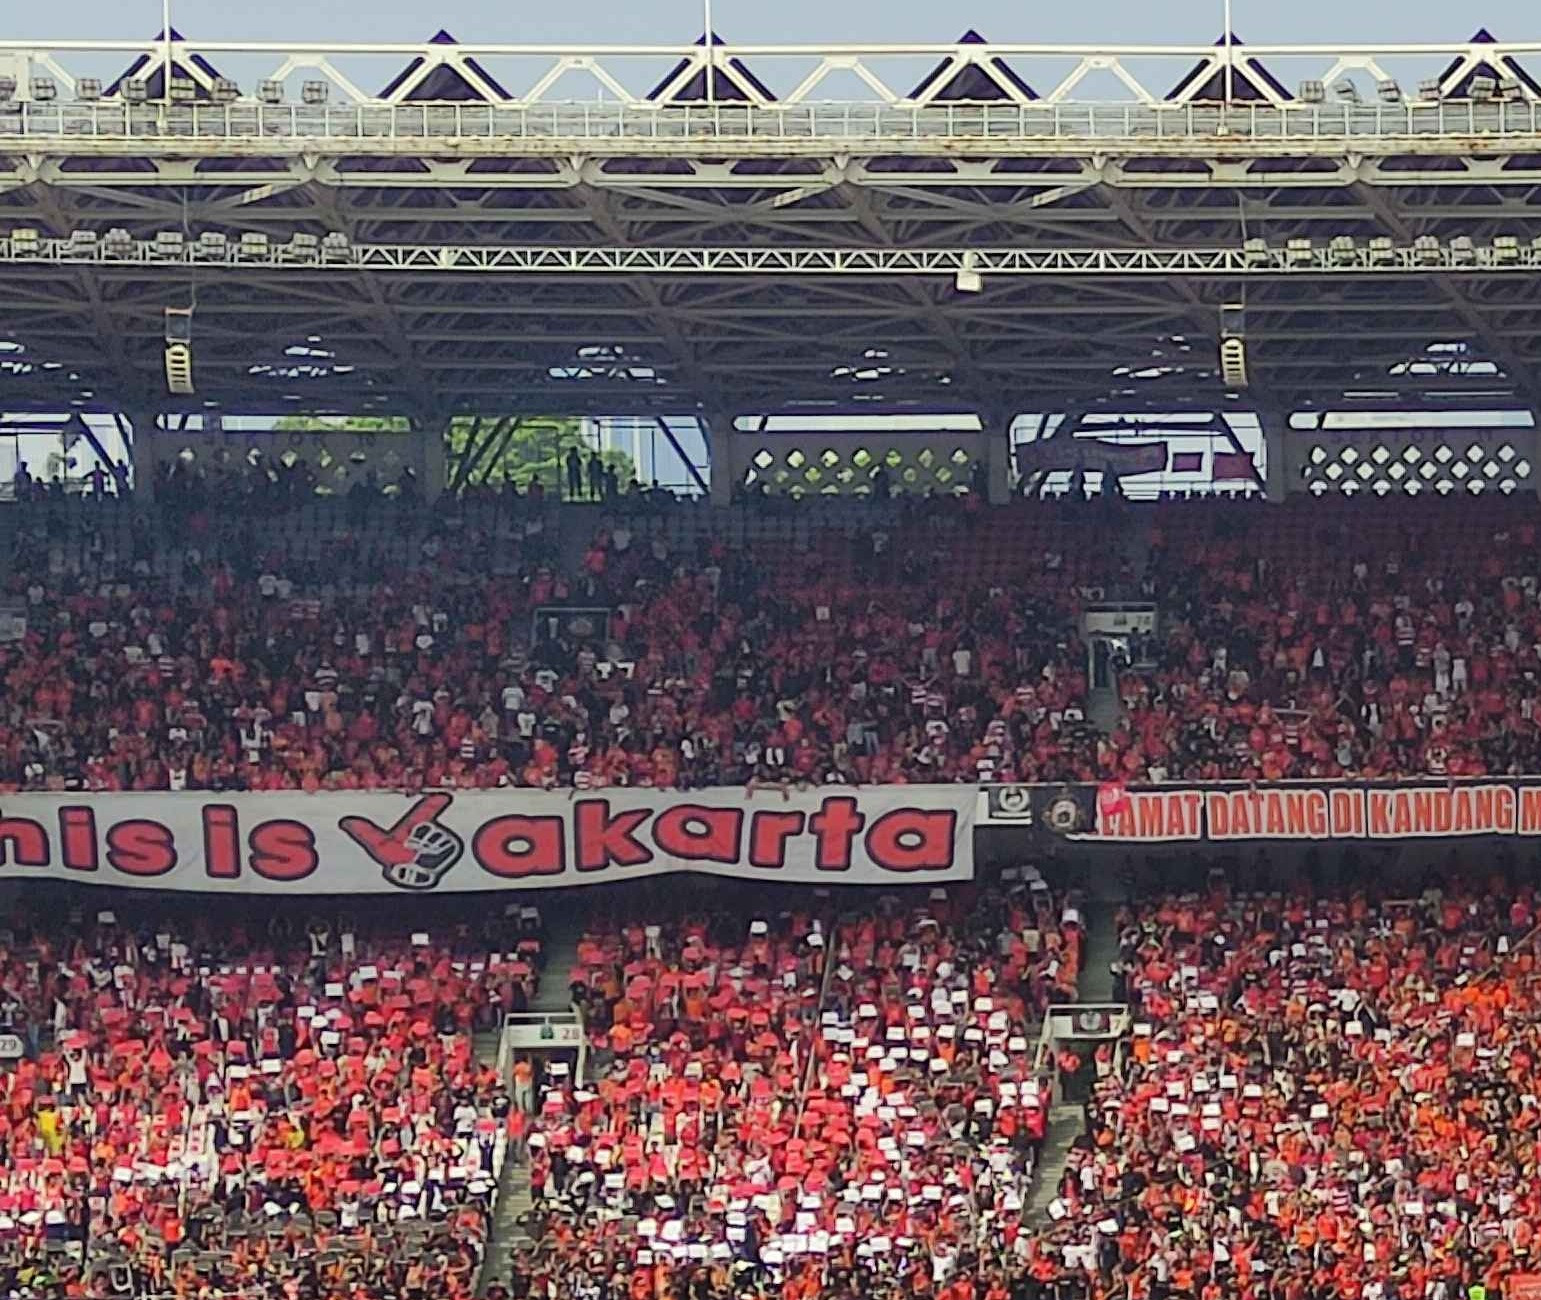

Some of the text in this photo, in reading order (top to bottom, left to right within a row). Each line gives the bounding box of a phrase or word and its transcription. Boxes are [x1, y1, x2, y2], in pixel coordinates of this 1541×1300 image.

[201, 803, 320, 882] is
[1206, 789, 1330, 838] DATANG
[1332, 789, 1364, 836] DI
[1368, 786, 1514, 836] KANDANG
